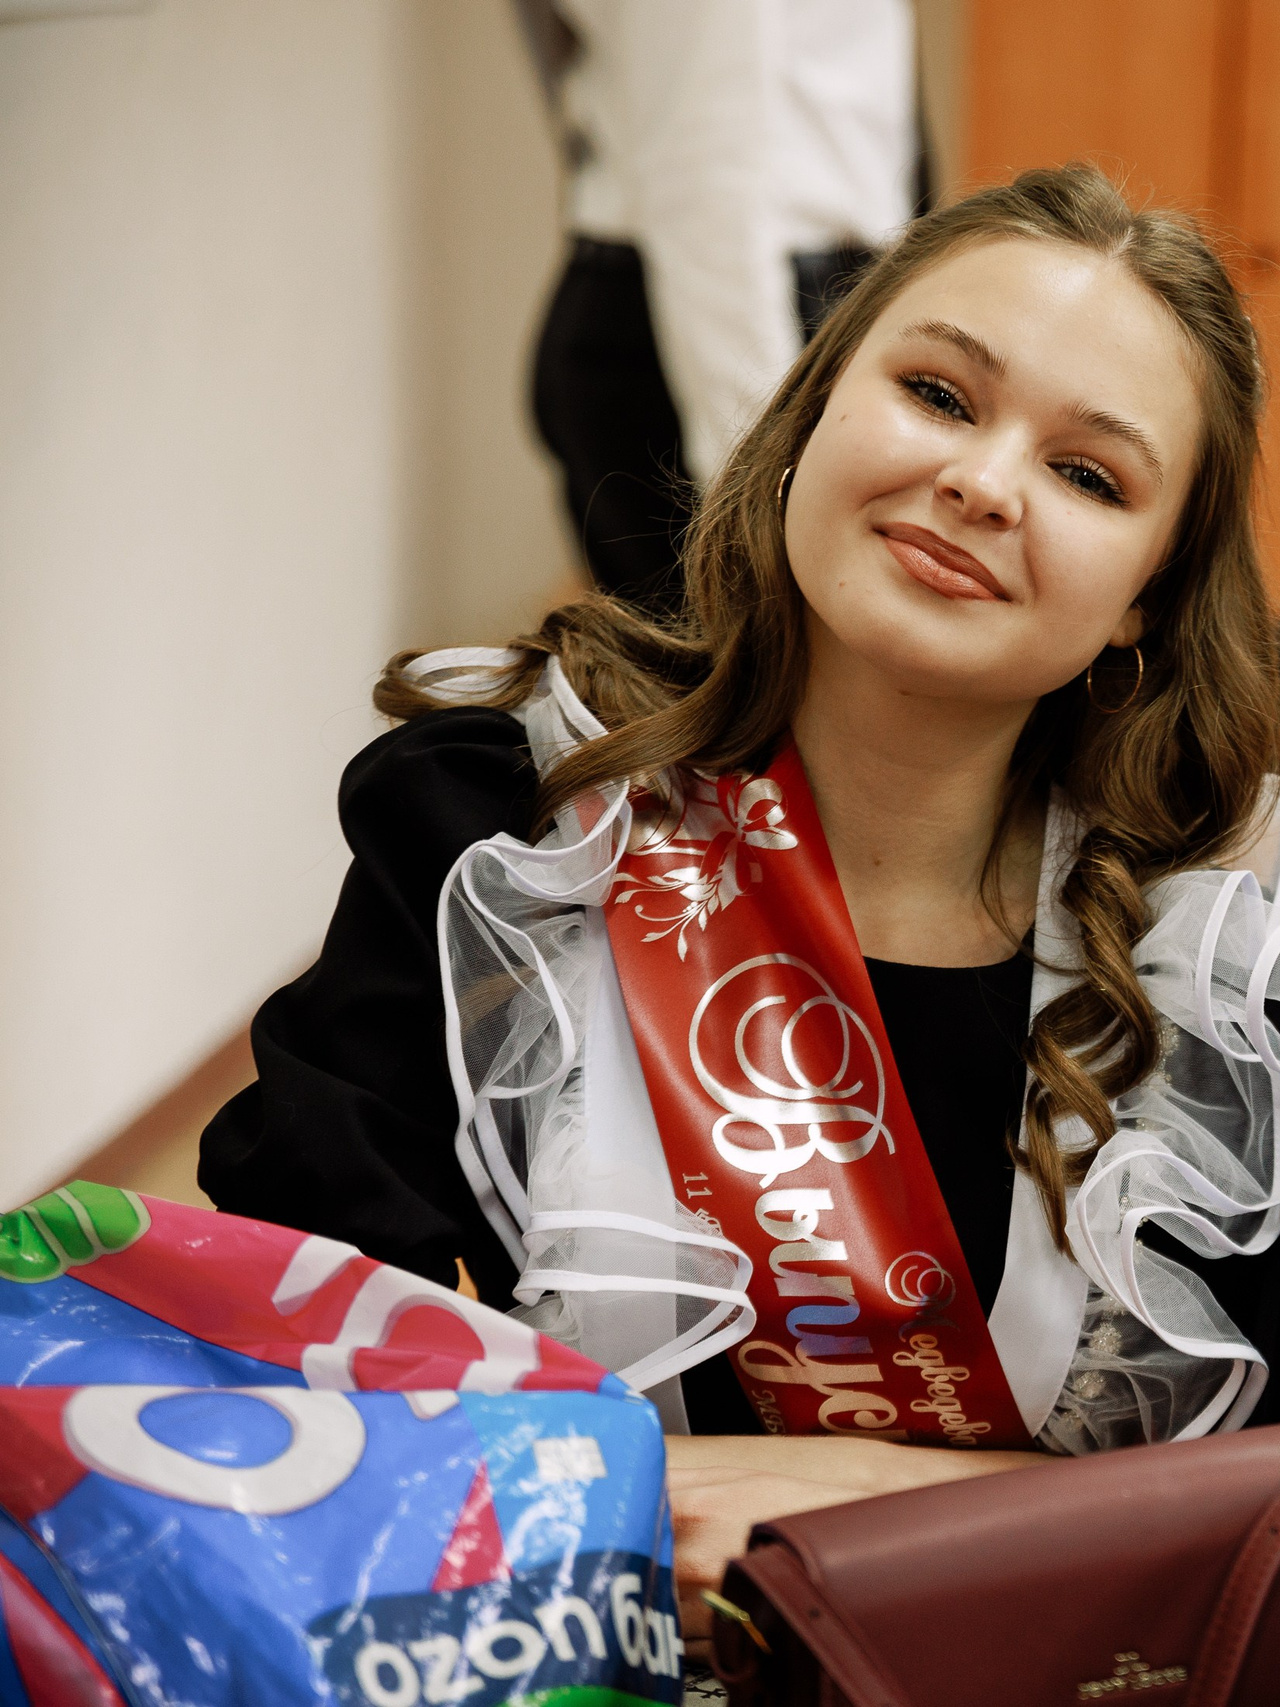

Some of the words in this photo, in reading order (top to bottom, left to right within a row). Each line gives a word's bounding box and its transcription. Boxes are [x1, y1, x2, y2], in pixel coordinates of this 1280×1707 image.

[681, 1171, 713, 1200] 11
[353, 1595, 609, 1707] ozon
[610, 1572, 685, 1680] бан
